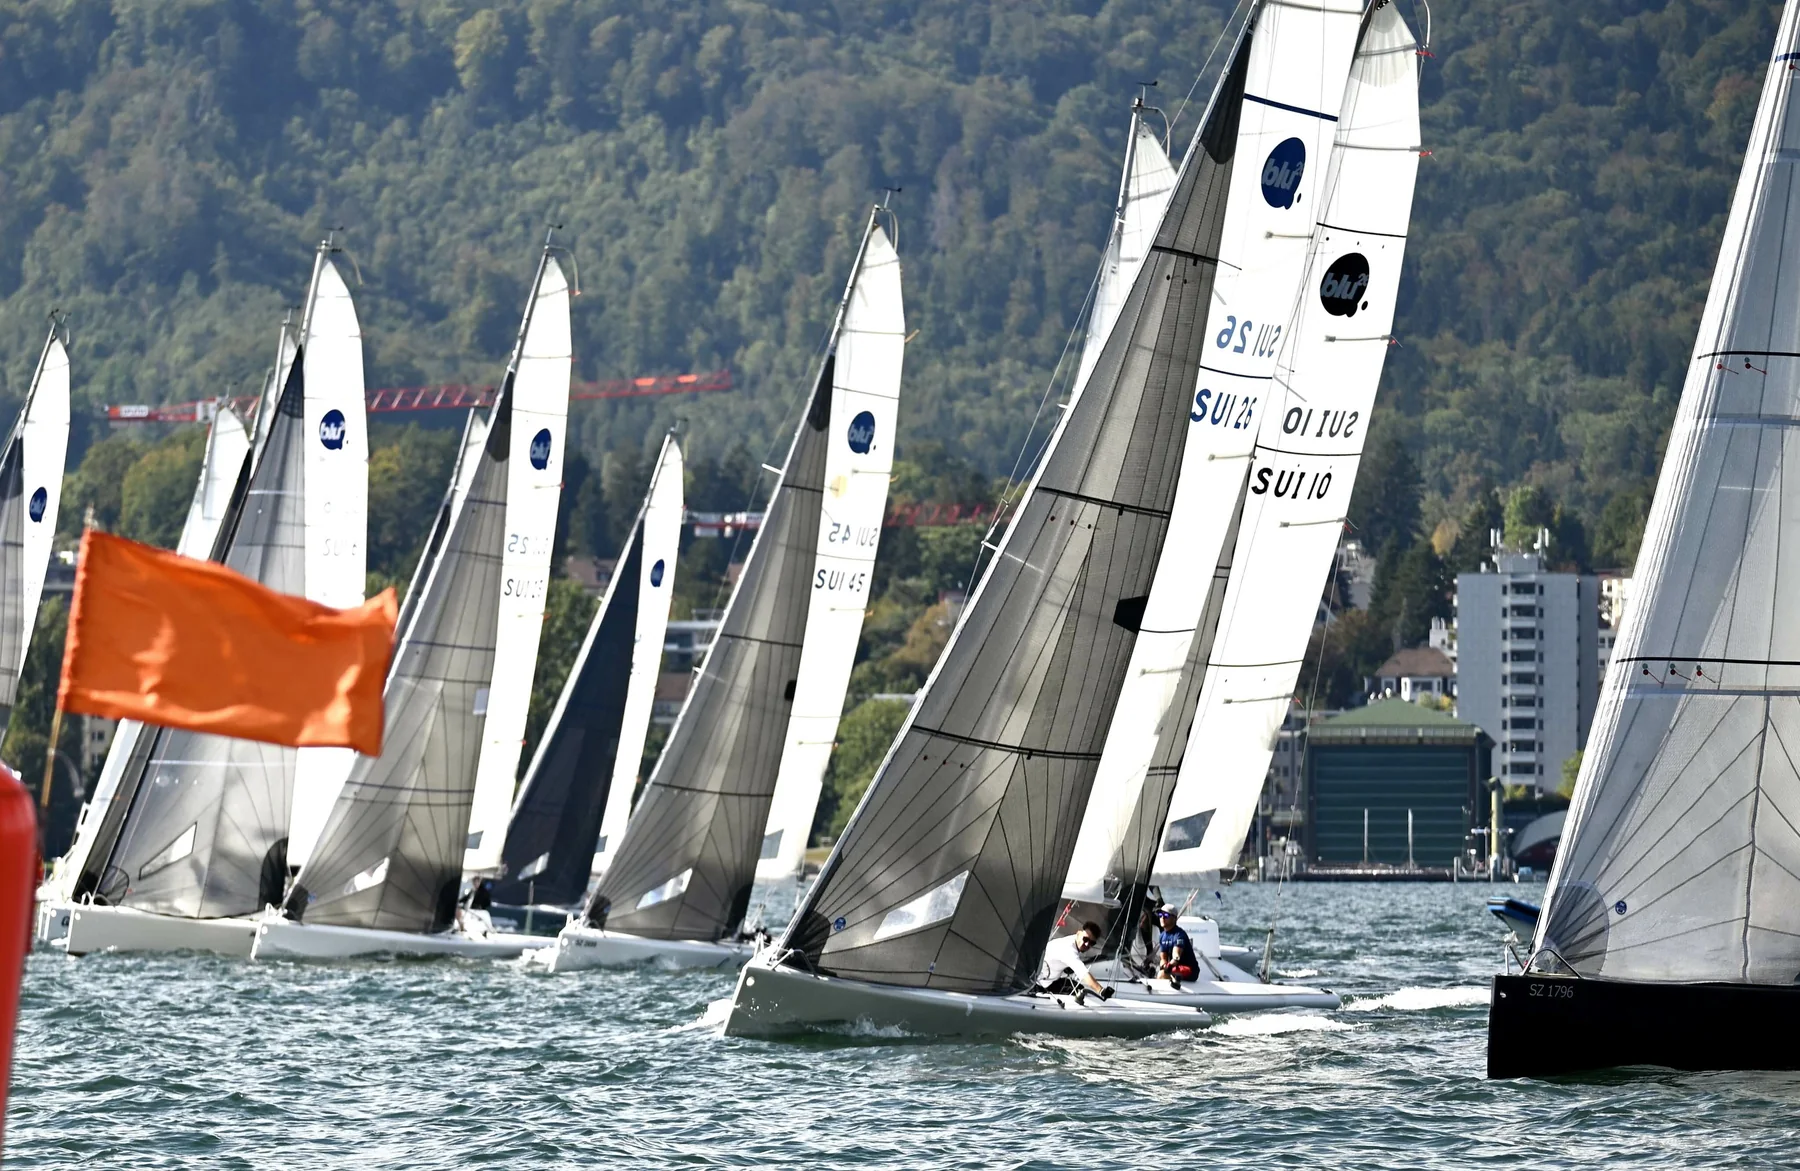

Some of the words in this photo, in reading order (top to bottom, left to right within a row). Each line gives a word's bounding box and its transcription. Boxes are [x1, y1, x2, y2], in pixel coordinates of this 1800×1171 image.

[1190, 388, 1237, 428] SUI
[1233, 396, 1257, 430] 26
[1251, 467, 1306, 499] SUI
[1307, 472, 1333, 500] 10
[815, 569, 846, 591] SUI
[1529, 983, 1545, 997] SZ
[1547, 984, 1574, 999] 1796
